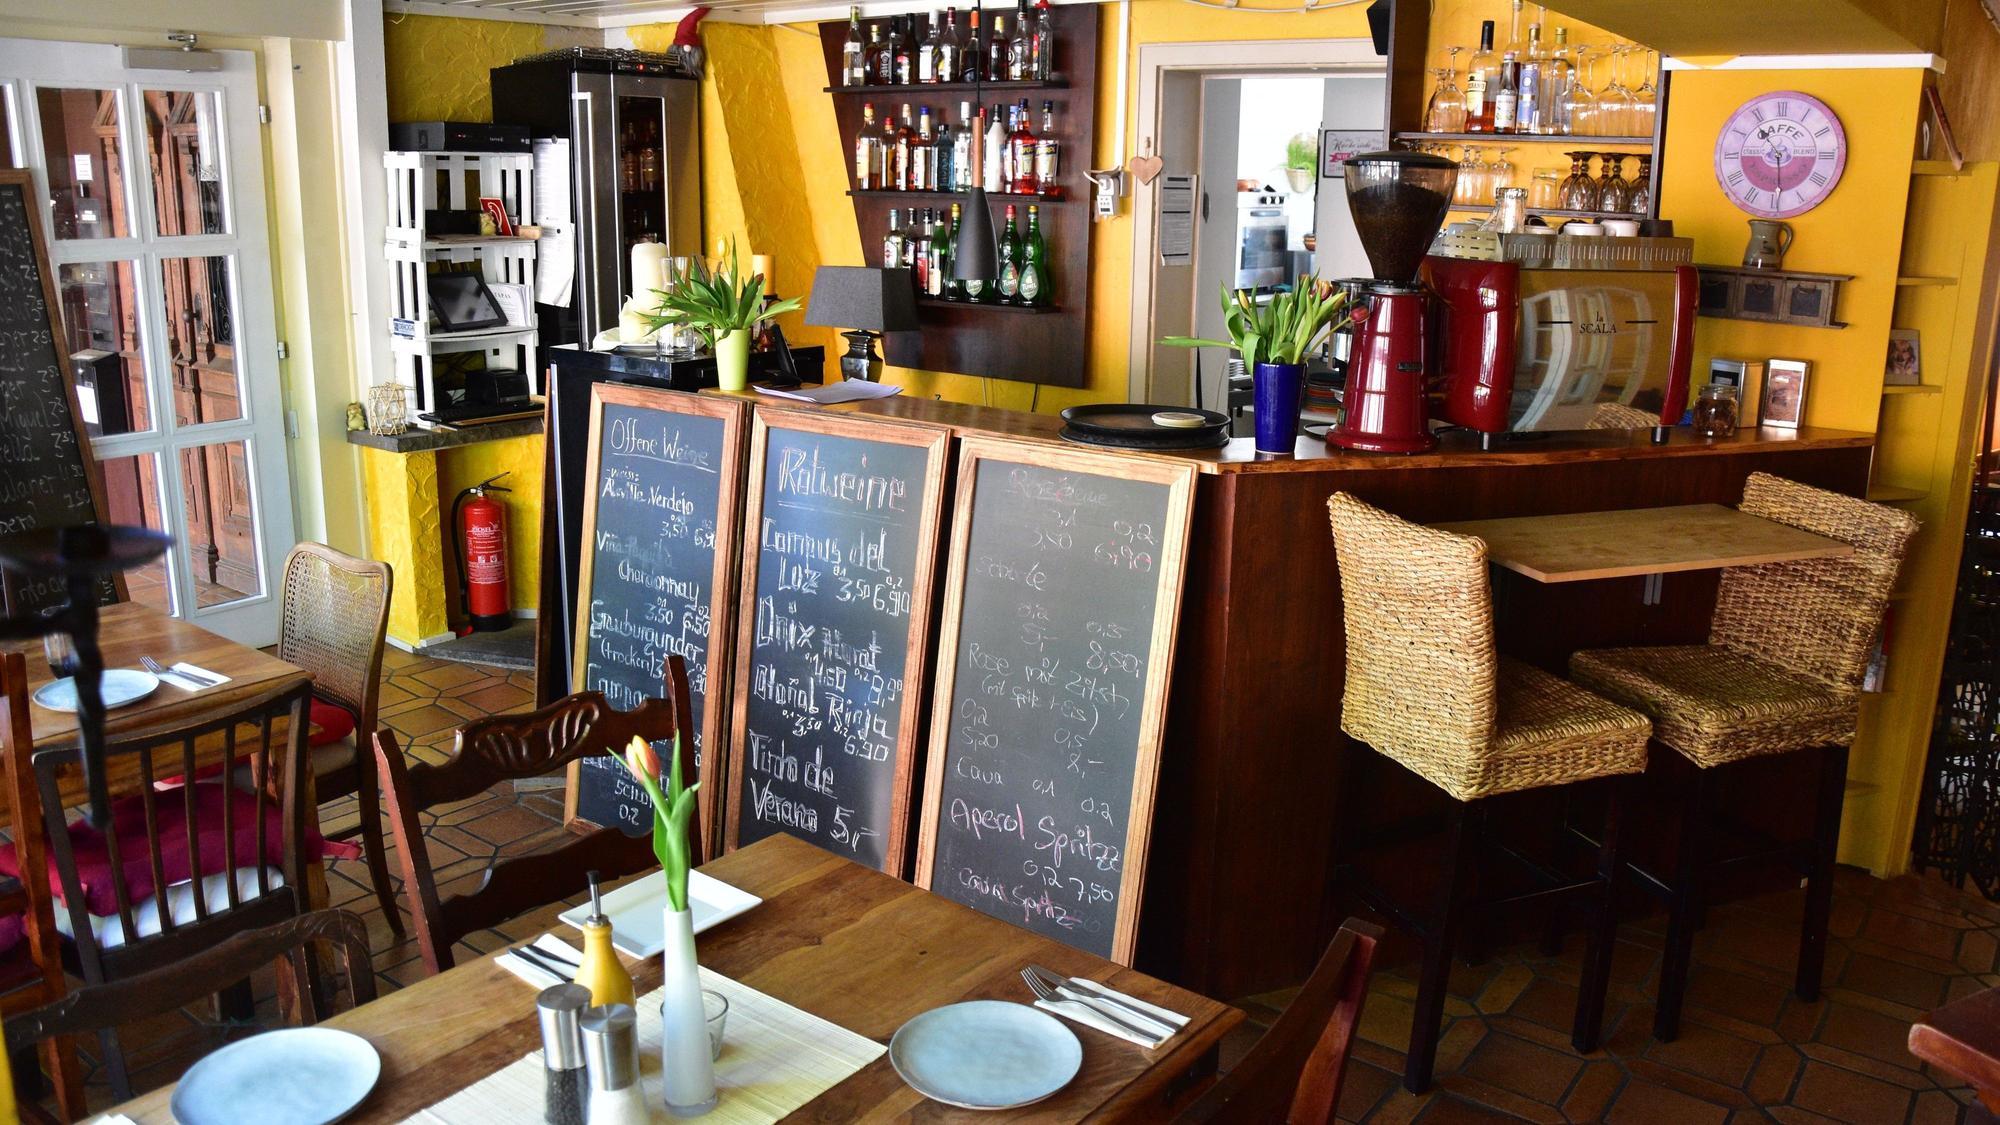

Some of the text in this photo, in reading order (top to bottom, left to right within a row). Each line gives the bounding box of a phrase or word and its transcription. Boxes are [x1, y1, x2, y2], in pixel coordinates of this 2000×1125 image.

[1580, 323, 1617, 334] SCALA
[611, 417, 658, 455] Offene
[779, 444, 906, 513] Rotweine
[804, 744, 838, 800] de
[957, 756, 1004, 786] Cava
[750, 777, 818, 833] Verano
[951, 798, 1026, 841] Aperol
[1069, 877, 1115, 904] 7,50
